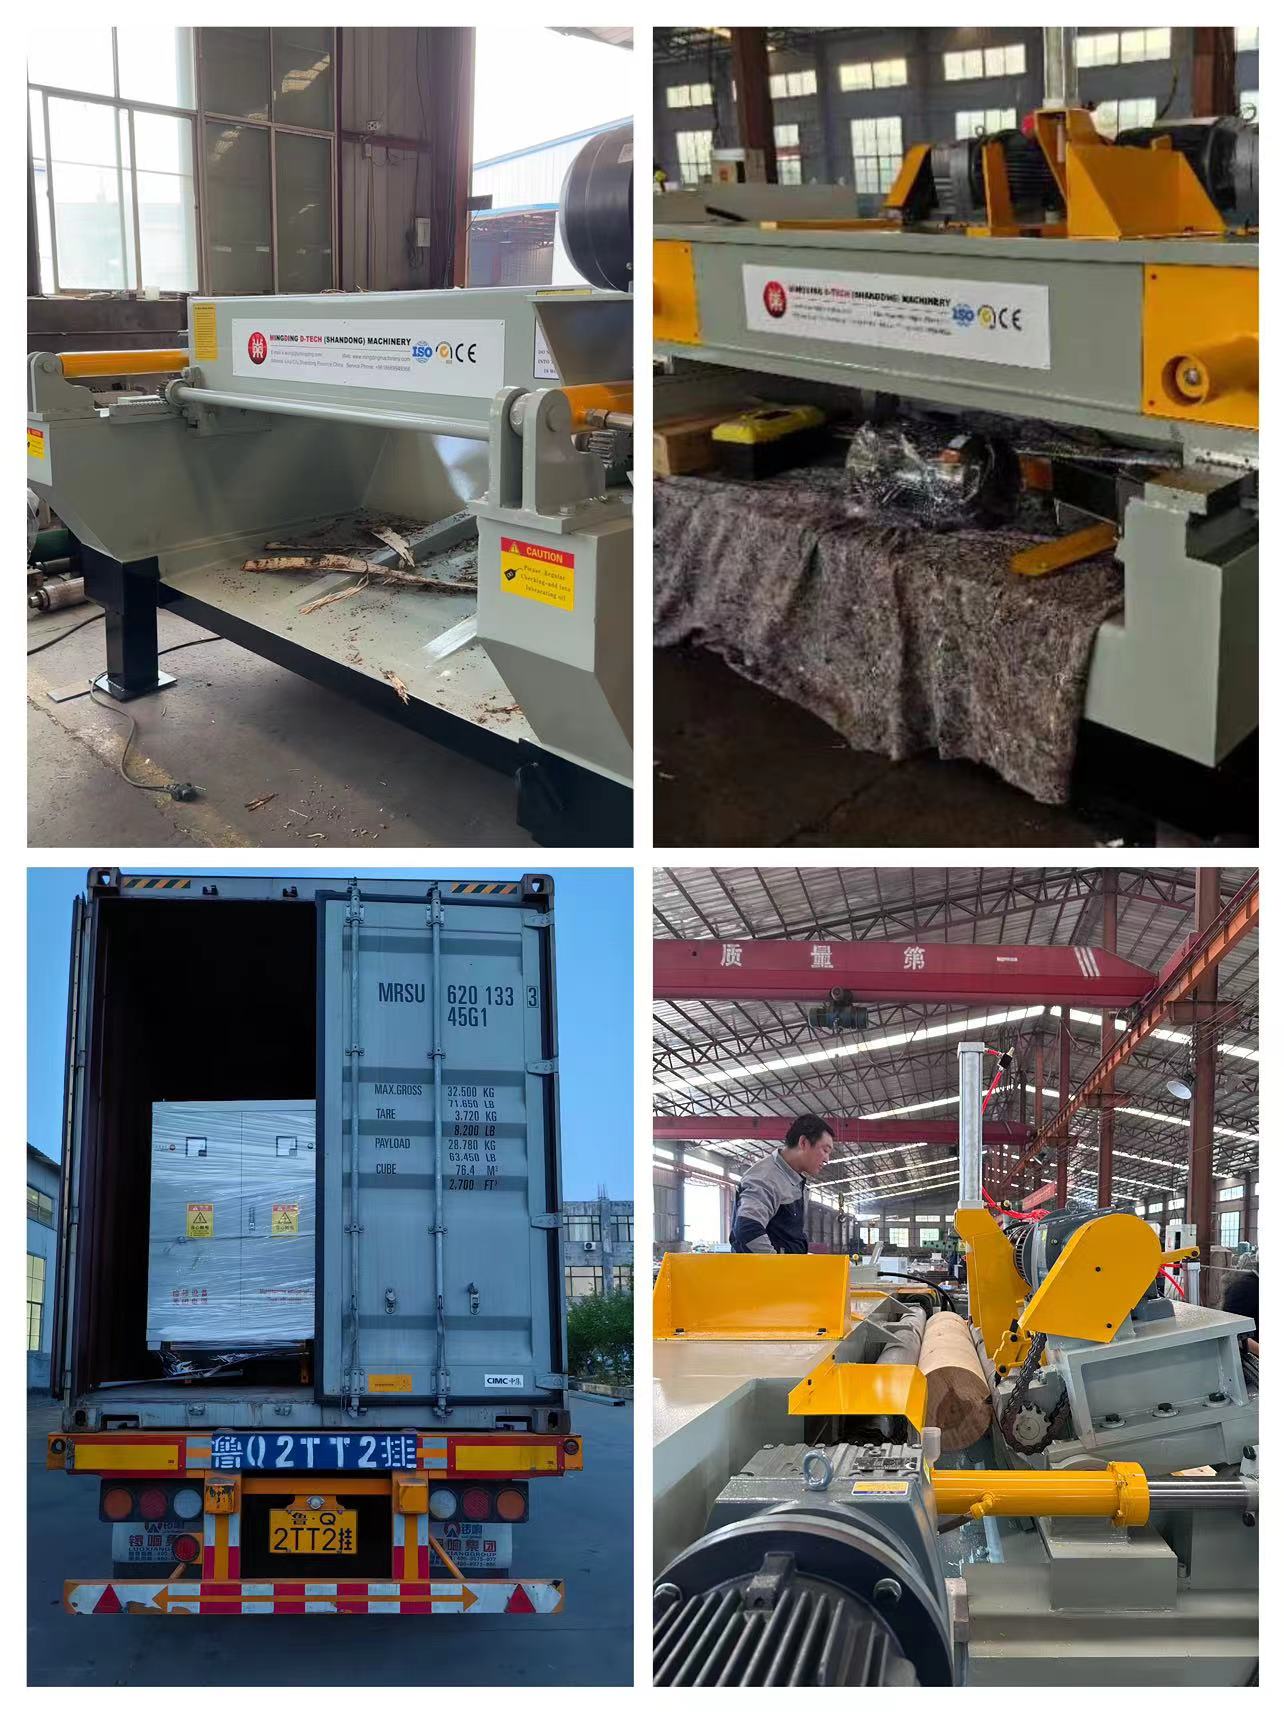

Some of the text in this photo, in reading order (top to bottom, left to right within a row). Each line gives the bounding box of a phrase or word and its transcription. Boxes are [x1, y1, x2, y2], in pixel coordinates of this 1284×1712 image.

[952, 307, 975, 322] ISO
[999, 307, 1022, 331] CE
[270, 334, 411, 346] MINGDING D-TECH (SHANDONG) MACHINERY
[412, 346, 433, 358] ISO
[455, 343, 477, 363] CE
[526, 547, 563, 563] CAUTION
[378, 982, 538, 1007] MRSU 620 133 3
[447, 1007, 487, 1027] 45G1
[374, 1084, 495, 1098] MAX.GROSS 32.500 KG
[484, 1100, 495, 1109] LB
[376, 1108, 396, 1119] TARE
[485, 1111, 497, 1122] KG
[485, 1125, 496, 1136] LB
[375, 1138, 411, 1149] PAYLOAD
[484, 1140, 496, 1151] KG
[485, 1153, 496, 1162] LB
[376, 1163, 397, 1175] CUBE
[456, 1165, 475, 1176] 76.4
[487, 1377, 508, 1385] CIMC
[274, 1528, 352, 1551] 2TT2挂
